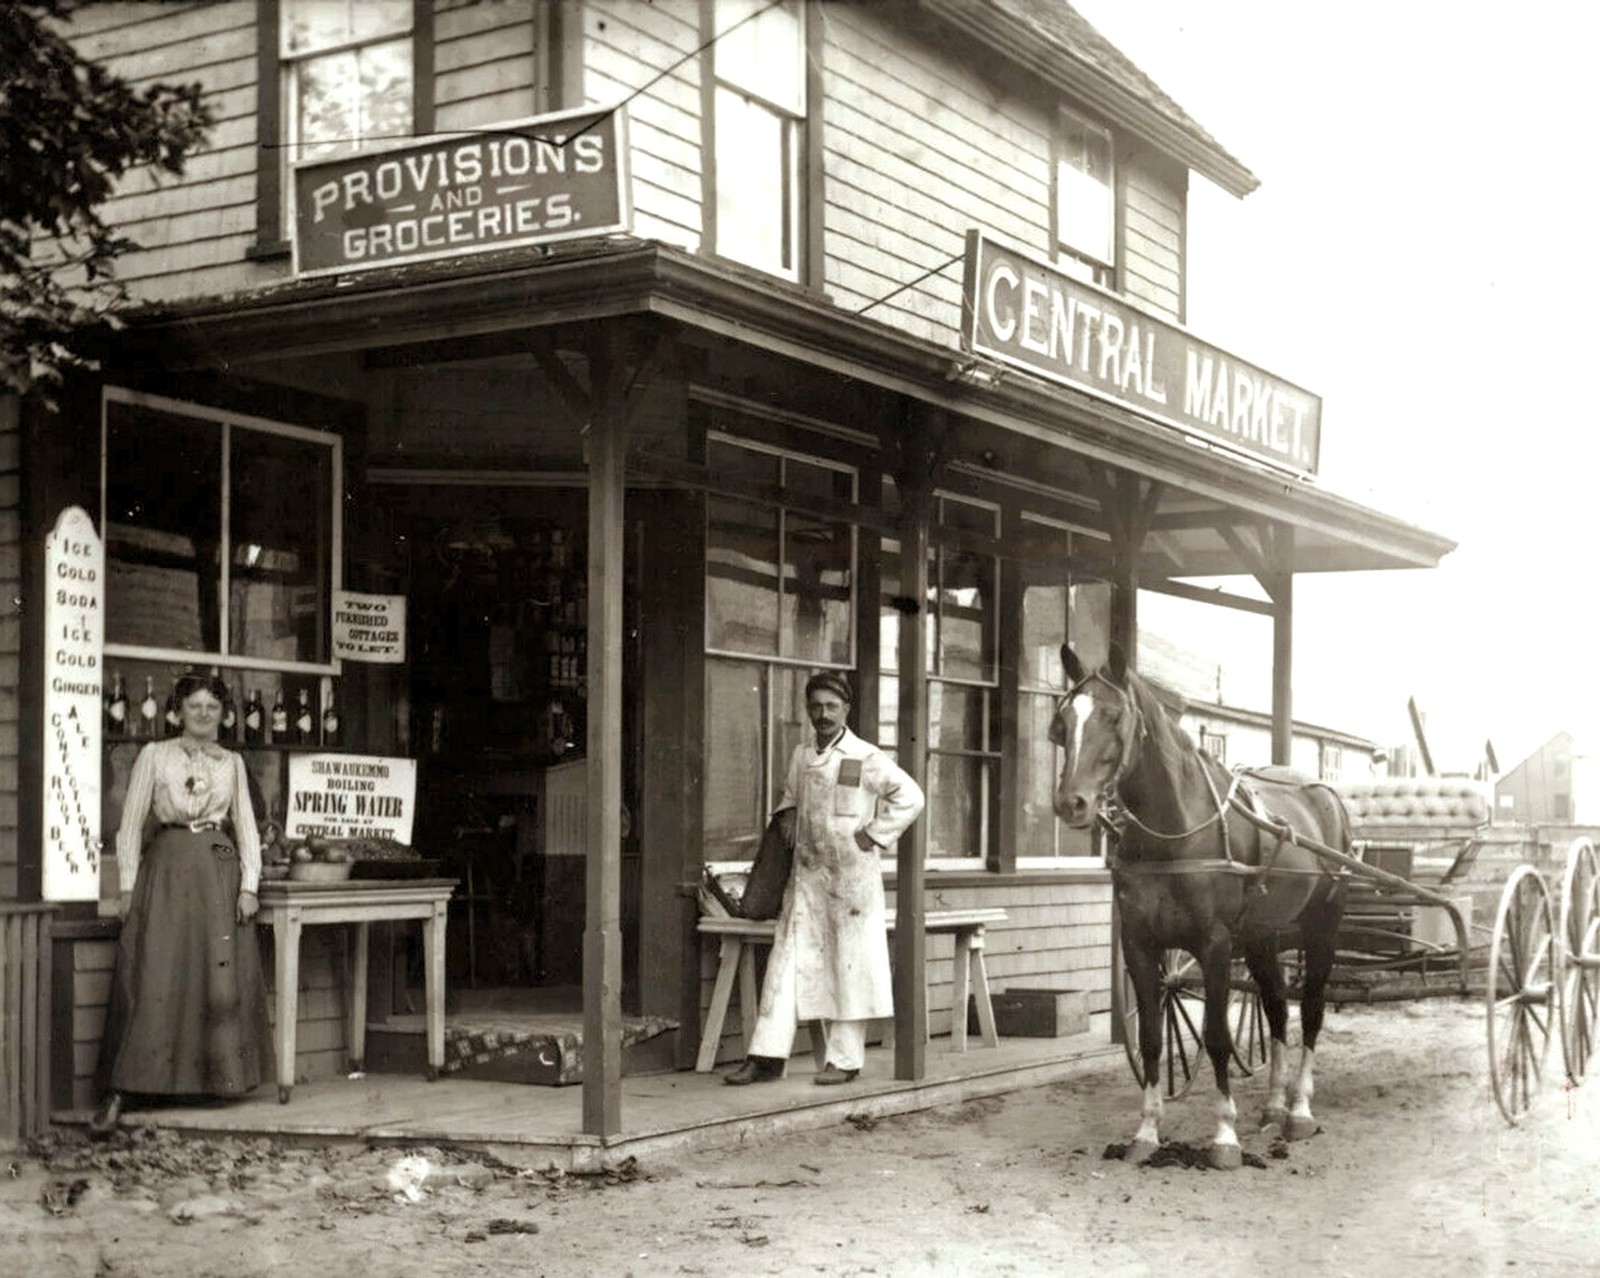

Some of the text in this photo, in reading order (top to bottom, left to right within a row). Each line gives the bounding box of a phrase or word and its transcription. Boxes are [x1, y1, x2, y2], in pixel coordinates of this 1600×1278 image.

[312, 134, 604, 224] PROVISIONS
[429, 186, 483, 213] AND
[343, 194, 582, 260] GROCERIES.
[986, 265, 1311, 462] CENTRAL MARKET.
[63, 536, 92, 556] ICE
[57, 562, 97, 582] COLD
[57, 591, 98, 609] SODA
[344, 601, 387, 612] TWO
[63, 625, 92, 642] ICE
[348, 628, 399, 642] COTTAGES
[335, 641, 355, 651] TO
[56, 650, 97, 668] COLD
[52, 677, 100, 696] GINGER
[68, 705, 90, 748] ALE
[327, 778, 376, 792] BOILING
[293, 791, 403, 818] SPRING WATER
[295, 823, 344, 839] CENTRAL
